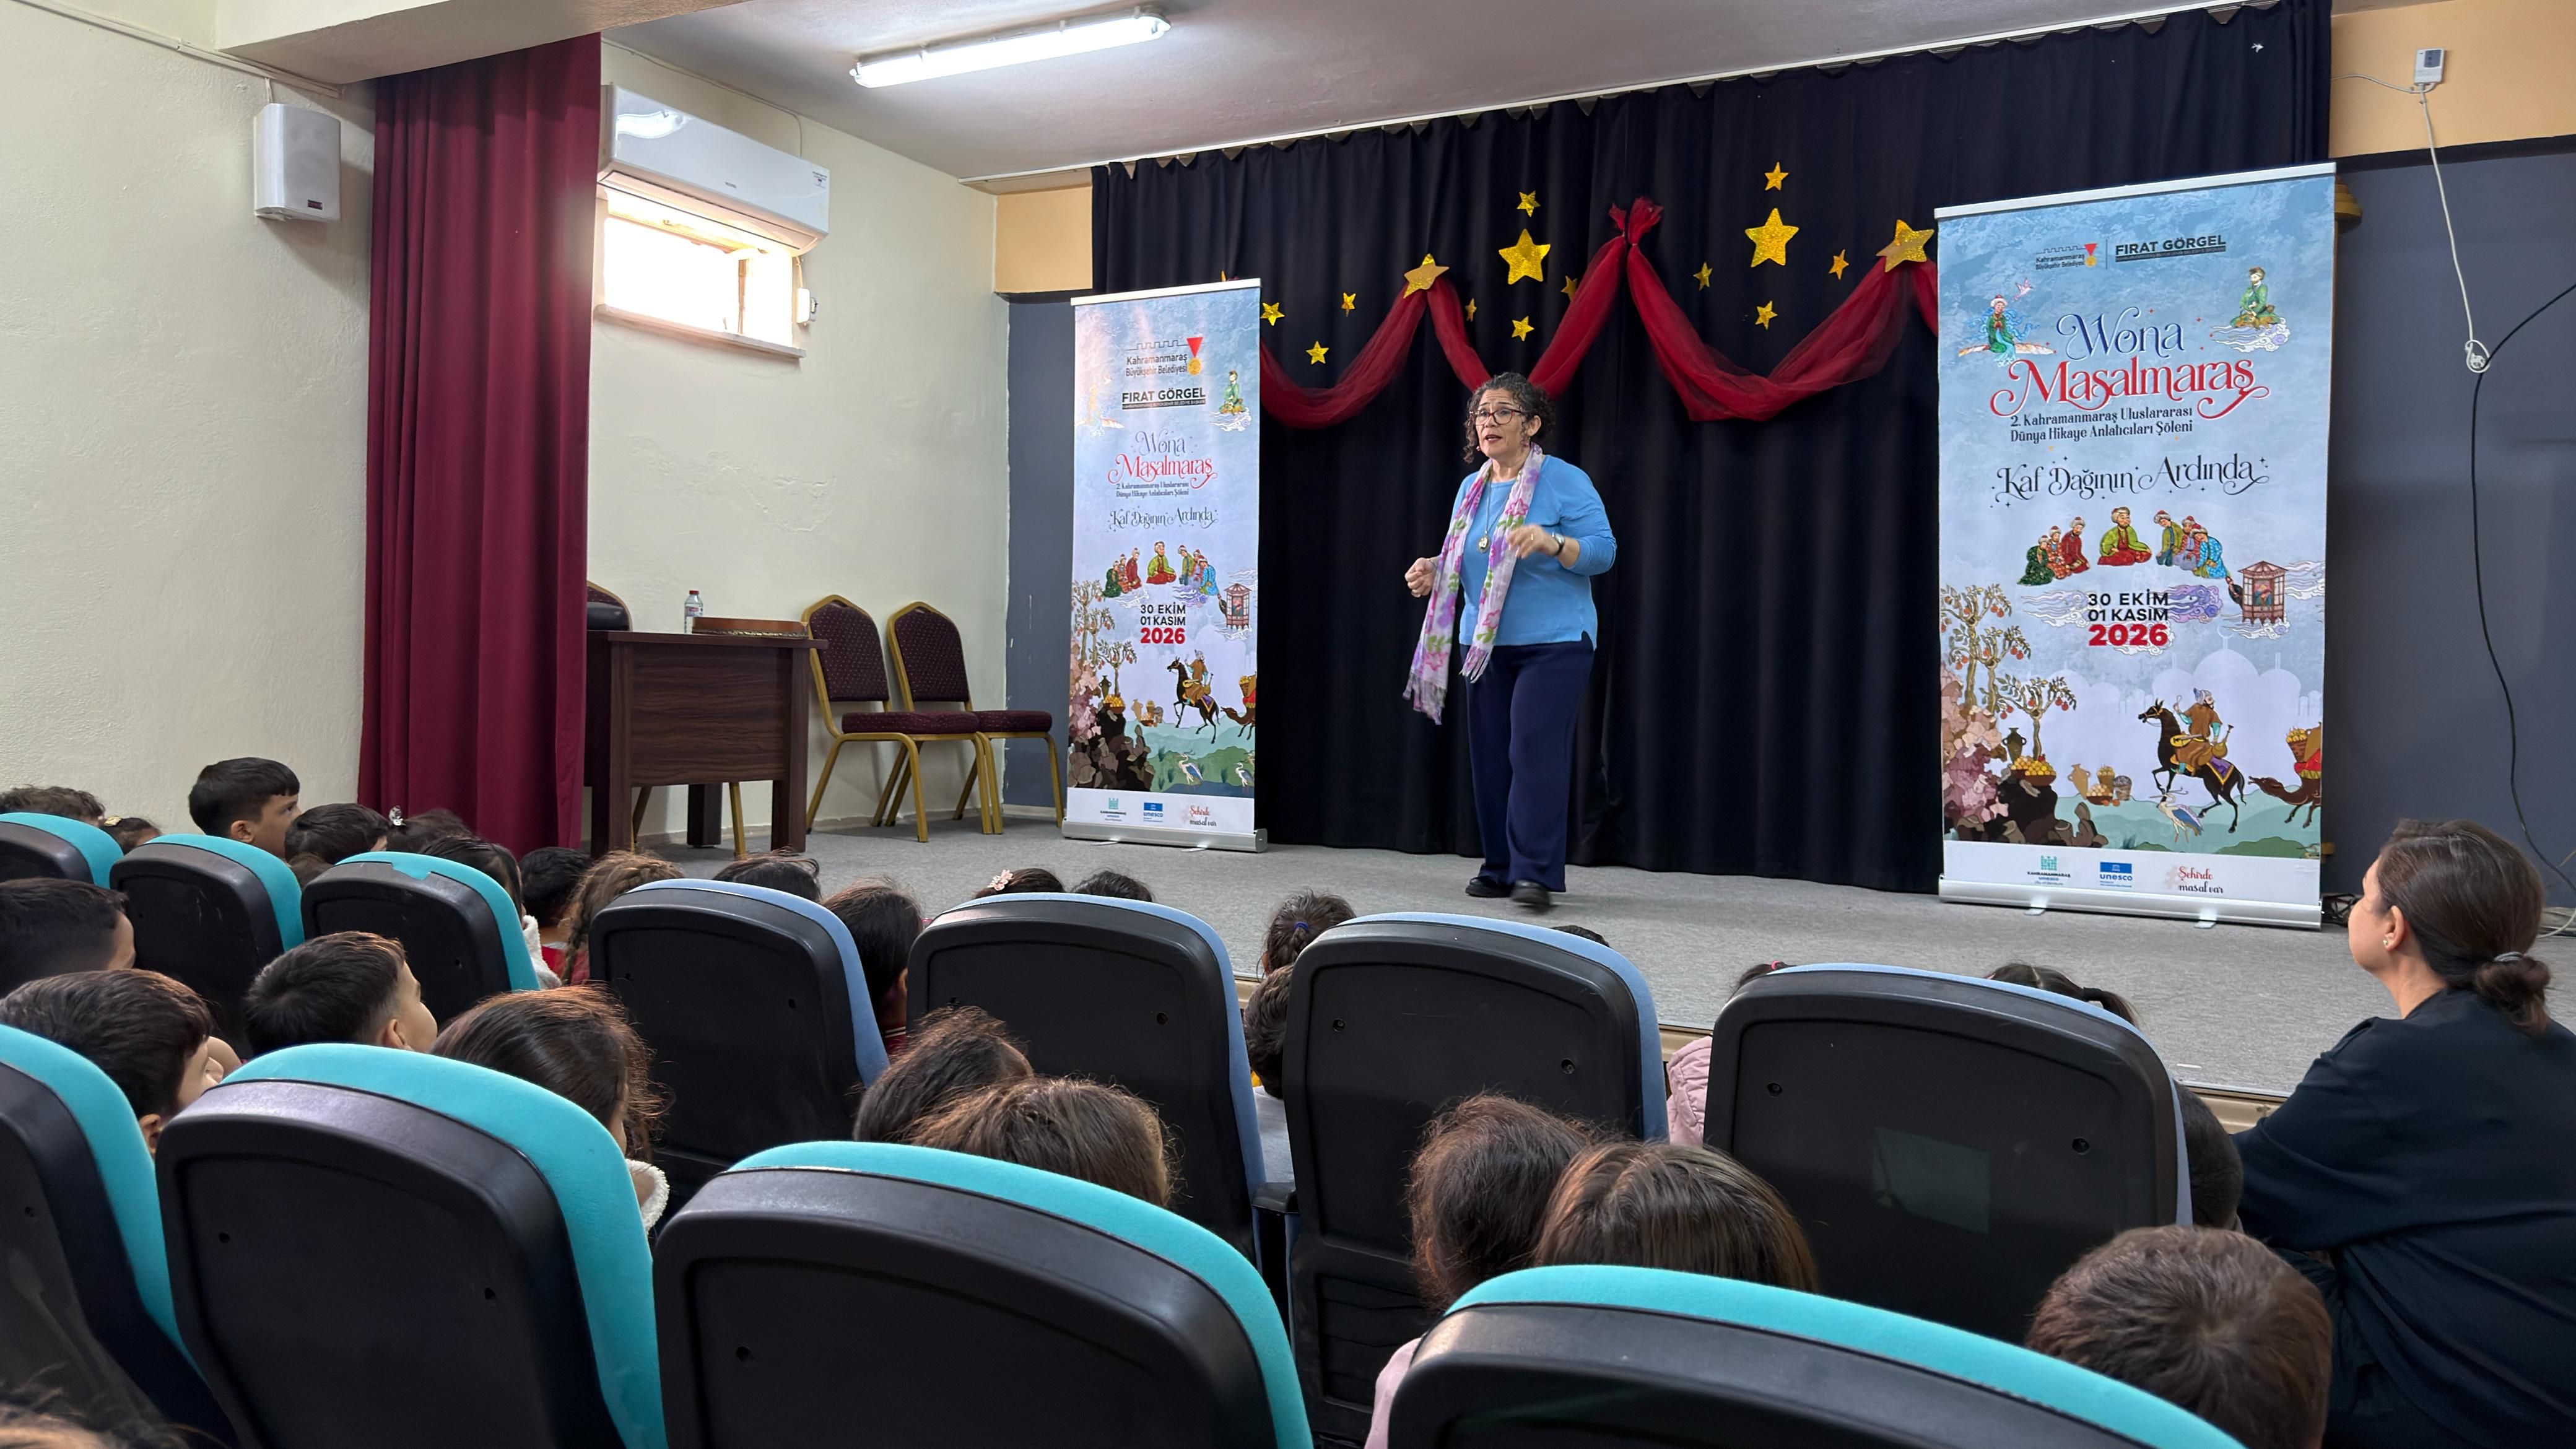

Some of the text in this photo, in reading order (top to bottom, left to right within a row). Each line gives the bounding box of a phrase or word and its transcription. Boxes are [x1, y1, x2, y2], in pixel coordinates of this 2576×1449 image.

[2115, 242, 2158, 255] FIRAT
[2163, 235, 2226, 250] GÖRGEL
[2056, 307, 2185, 360] Wona
[1126, 354, 1188, 365] Kahramanmaraş
[1126, 362, 1188, 378] Büyükşehir Belediyesi
[1122, 387, 1206, 402] FIRAT GÖRGEL
[2010, 406, 2193, 427] 2. Kahramanmaraş Uluslararası
[2011, 420, 2193, 444] Dünya Hikaye Anlatıcıları Şöleni
[1135, 429, 1186, 456] Wona
[1995, 453, 2269, 502] Kaf Dağının Ardında
[1109, 506, 1219, 531] Kaf Dağının Ardında
[2088, 588, 2168, 606] 30 EKİM
[1141, 601, 1186, 614] 30 EKİM
[2088, 609, 2168, 621] 01 KASIM
[1140, 616, 1186, 625] 01 KASIM
[1140, 627, 1186, 645] 2026
[2089, 624, 2168, 646] 2026
[2179, 881, 2208, 892] masal
